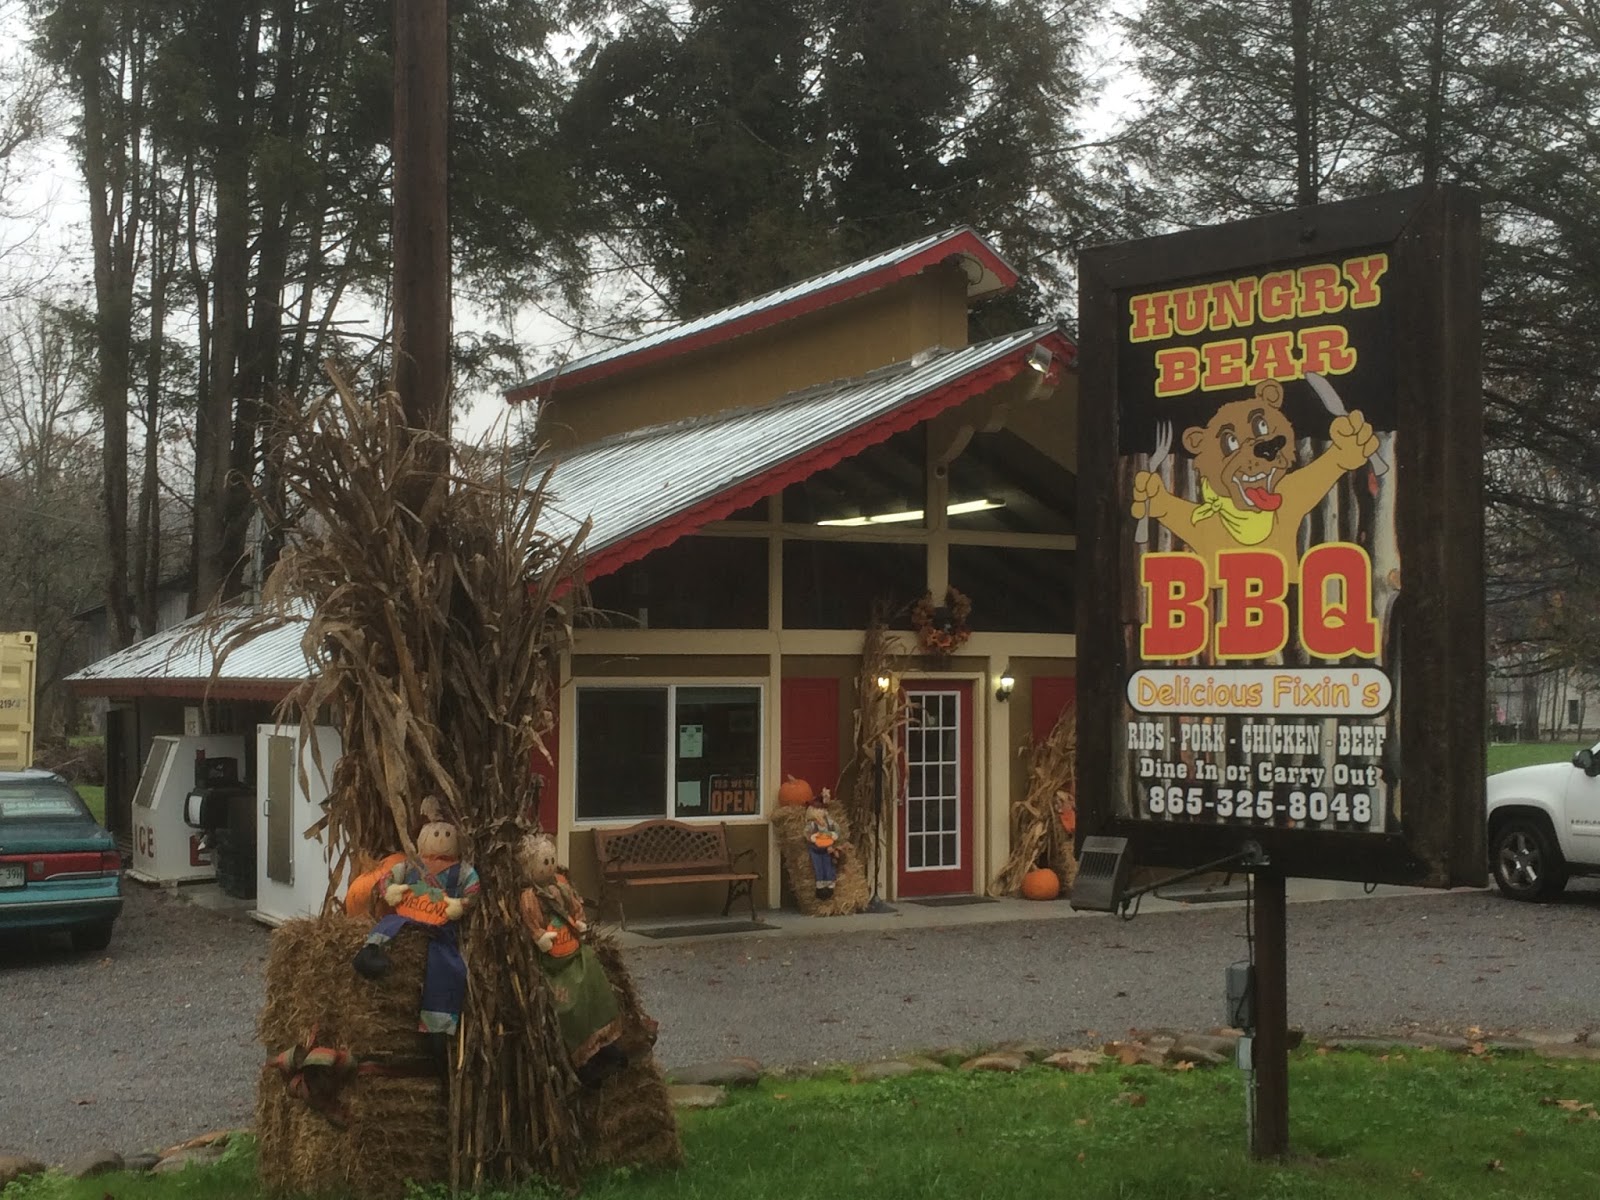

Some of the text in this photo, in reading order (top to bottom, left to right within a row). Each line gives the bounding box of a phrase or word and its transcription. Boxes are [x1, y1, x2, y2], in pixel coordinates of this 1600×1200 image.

[1130, 253, 1388, 343] HUNGRY
[1155, 325, 1357, 398] BEAR
[1140, 541, 1380, 661] BBQ
[1137, 673, 1381, 708] Delicious Fixin's
[1128, 722, 1165, 750] RIBS
[1181, 722, 1225, 752] PORK
[1241, 724, 1320, 755] CHICKEN
[1338, 725, 1387, 756] BEEF
[1140, 757, 1378, 788] Dine In or Carry Out
[711, 790, 755, 813] OPEN
[1149, 786, 1371, 822] 865-325-8048
[134, 823, 154, 858] ICE
